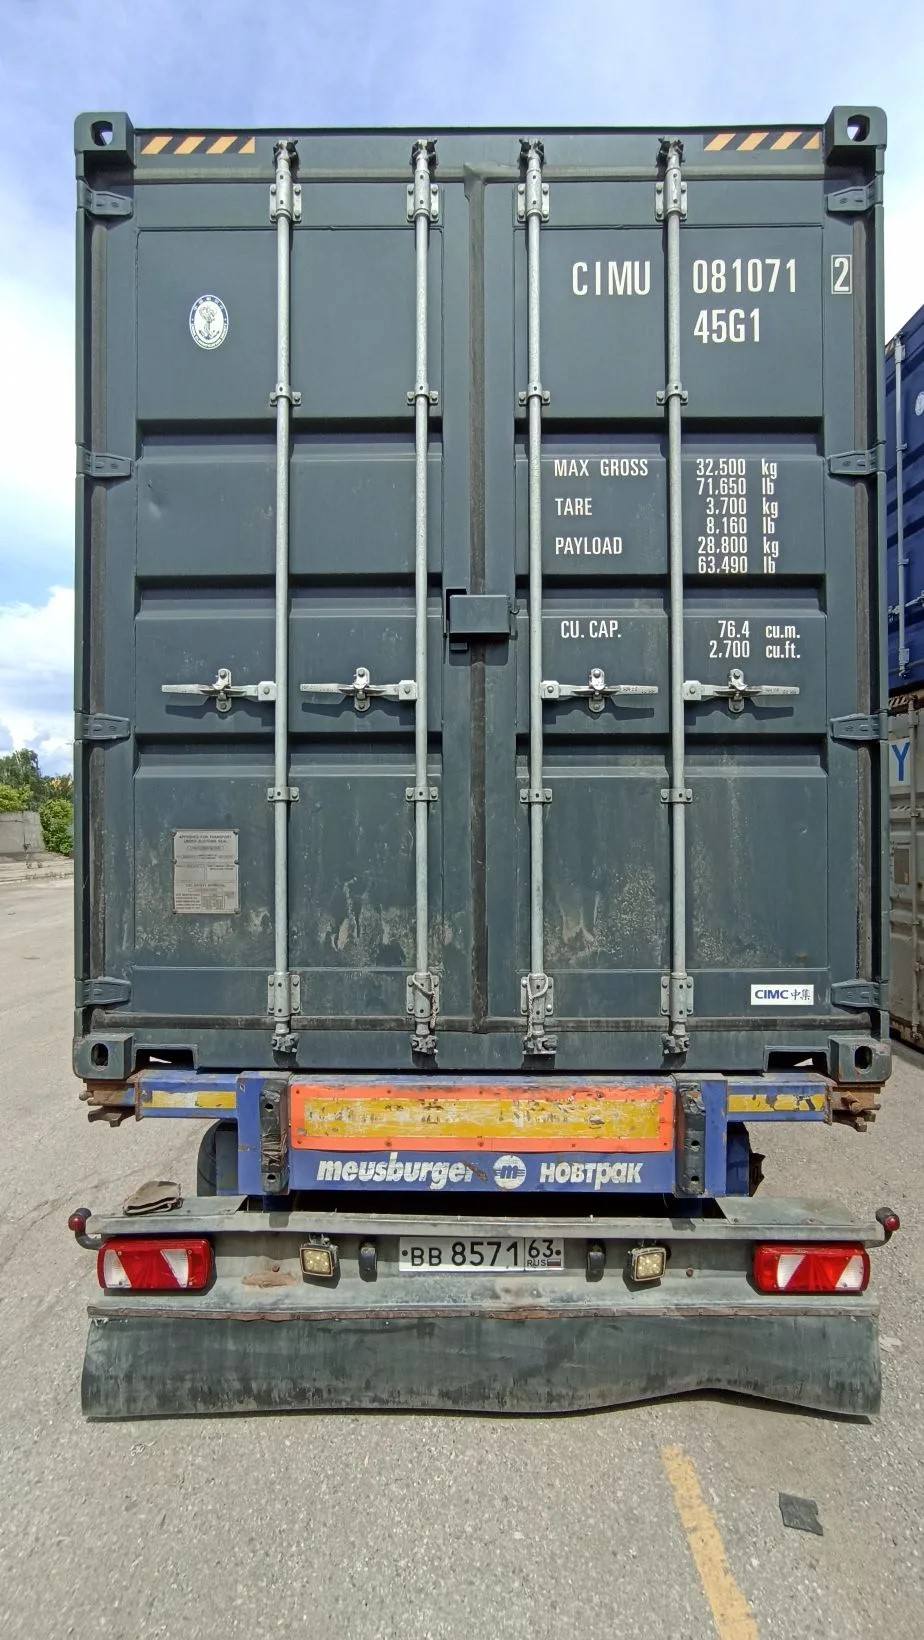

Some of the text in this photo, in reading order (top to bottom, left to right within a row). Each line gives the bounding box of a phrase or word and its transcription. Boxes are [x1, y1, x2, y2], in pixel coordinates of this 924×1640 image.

[572, 257, 851, 296] CIMU 081071 2
[693, 307, 760, 344] 45G1
[553, 458, 590, 477] MAX
[599, 458, 649, 477] GROSS
[760, 458, 778, 480] kg
[761, 477, 776, 495] lb
[554, 497, 593, 516] TARE
[761, 497, 779, 519] kg
[762, 516, 776, 534] lb
[555, 536, 623, 555] PAYLOAD
[762, 536, 779, 558] kg
[763, 555, 776, 574] lb
[560, 620, 801, 639] CU. CAP. 76.4 cu.m.
[765, 641, 801, 659] cu.ft.
[754, 989, 789, 1000] CIMC
[316, 1151, 474, 1190] meusburger
[451, 1241, 519, 1267] 8571
[527, 1239, 554, 1259] 63
[526, 1258, 548, 1268] RUS
